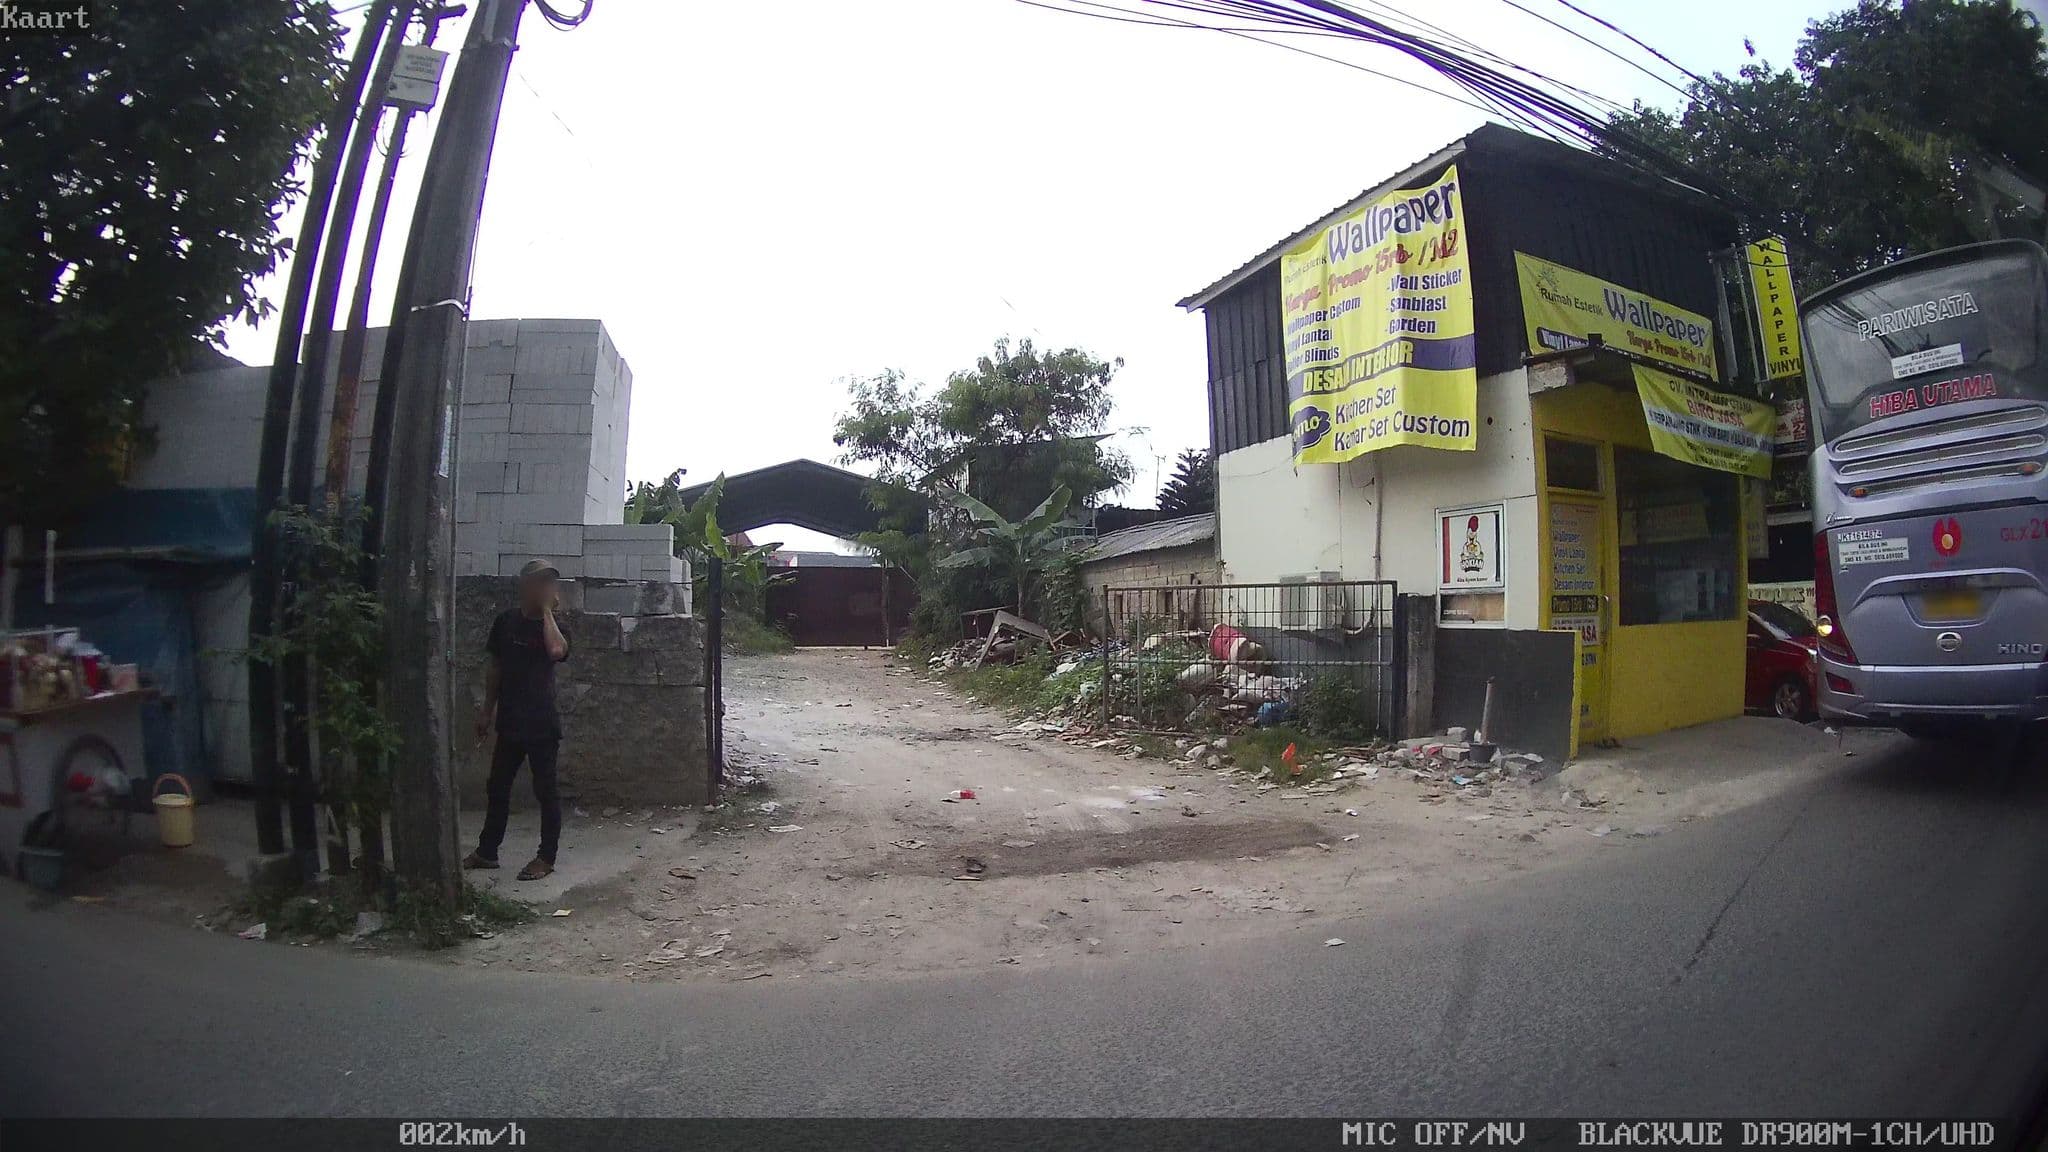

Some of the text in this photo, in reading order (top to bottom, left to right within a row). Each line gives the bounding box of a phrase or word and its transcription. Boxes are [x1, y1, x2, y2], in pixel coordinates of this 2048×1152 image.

[1328, 182, 1456, 264] Wallpaper
[1422, 269, 1462, 290] Sticker
[1540, 288, 1572, 307] Rumah
[1759, 241, 1790, 356] WALLPAPER
[1603, 287, 1706, 347] Wallpaper
[1858, 292, 1979, 342] PARIWISATA
[1304, 346, 1339, 363] Blinds
[1350, 340, 1413, 382] INTERIOR
[1375, 385, 1397, 409] Set
[1870, 373, 1998, 419] HIBA UTAMA
[1368, 416, 1389, 439] Set
[1393, 410, 1470, 438] Custom
[1998, 643, 2044, 655] HINO
